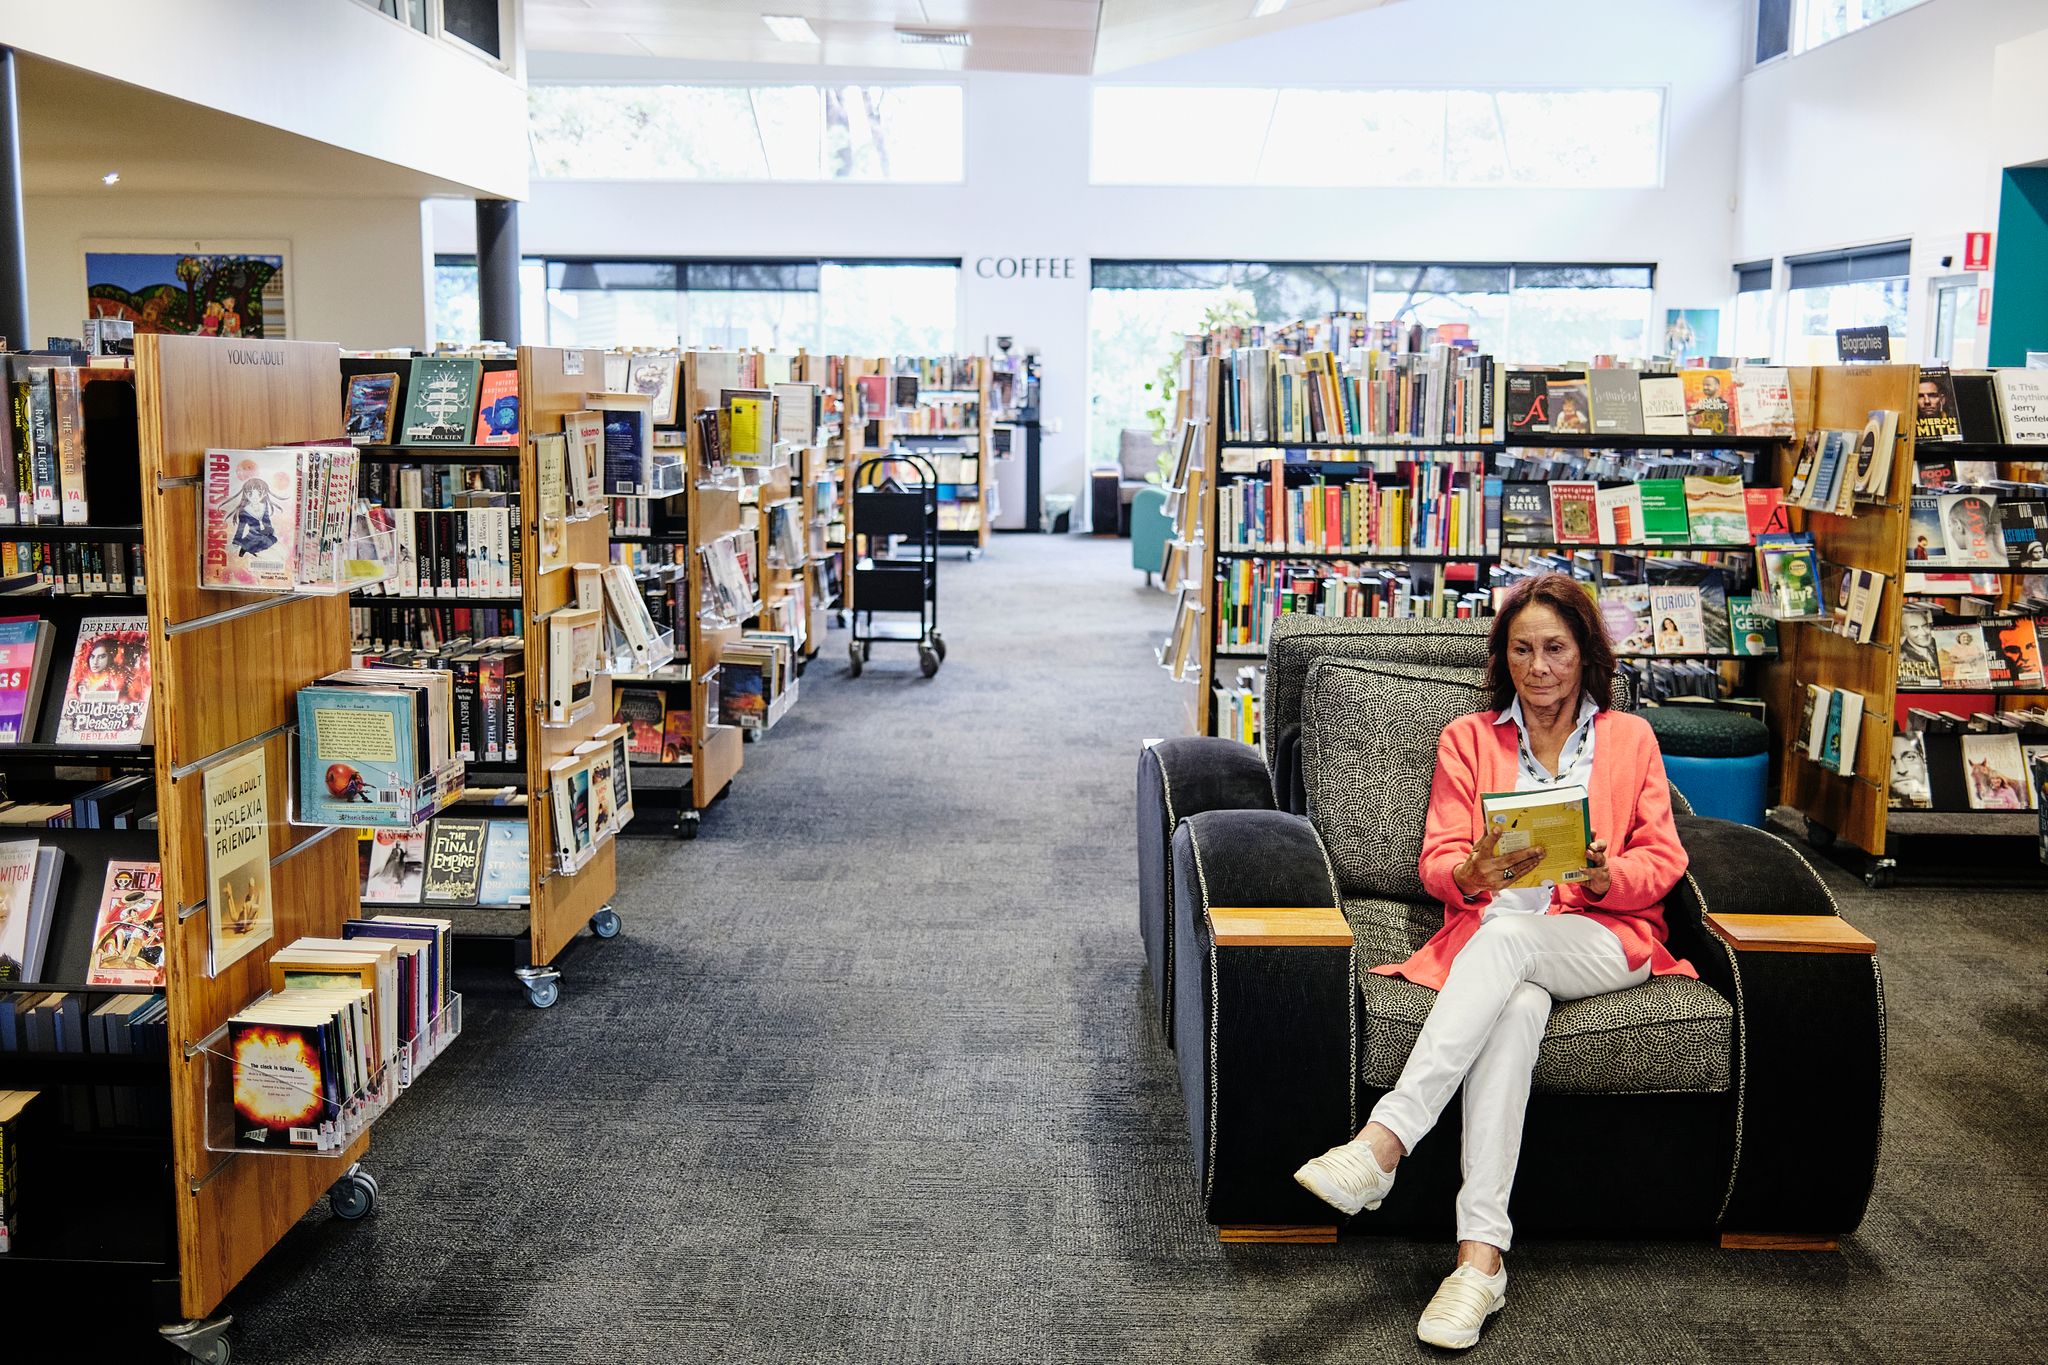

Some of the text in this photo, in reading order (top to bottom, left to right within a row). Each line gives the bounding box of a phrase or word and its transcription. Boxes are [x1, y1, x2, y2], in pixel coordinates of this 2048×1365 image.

[976, 257, 1075, 279] COFFEE
[1841, 334, 1882, 354] Biographies
[227, 349, 285, 366] YOUNG ADULT
[1482, 383, 1491, 425] LANGUAGE
[2012, 404, 2036, 413] Jerry
[1915, 416, 1957, 425] AMERON
[1916, 424, 1959, 437] MITH
[35, 409, 48, 481] RAVEN FLIGHT
[62, 414, 75, 476] THE CALLER
[39, 488, 52, 498] YA
[67, 490, 80, 500] YA
[1509, 495, 1540, 503] DARK
[1553, 487, 1595, 495] Aboriginal
[1553, 493, 1595, 501] Mythology
[207, 453, 230, 567] FRUITS BASKET
[1509, 502, 1541, 511] SKIES
[1909, 499, 1938, 508] RTEEN
[2018, 504, 2032, 518] OUR
[1964, 499, 1989, 559] BRAVE
[2032, 515, 2047, 529] MAN
[1655, 592, 1697, 611] CURIOUS
[81, 622, 149, 632] DEREK LAN
[1735, 617, 1772, 630] GEEK
[1897, 668, 1939, 677] HITLAM
[66, 699, 144, 718] Skulduggery
[460, 701, 469, 725] BRENT
[74, 714, 130, 731] Pleasant
[506, 696, 516, 744] THE MARTIA
[80, 732, 118, 741] BEDLAM
[213, 774, 262, 807] YOUNG ADULT
[214, 798, 263, 836] DYSLEXIA
[216, 820, 263, 859] FRIENDLY
[376, 830, 423, 841] SANDERSON
[449, 831, 466, 840] THE
[436, 837, 476, 854] FINAL
[433, 853, 475, 873] EMPIRE
[0, 863, 30, 885] WITCH
